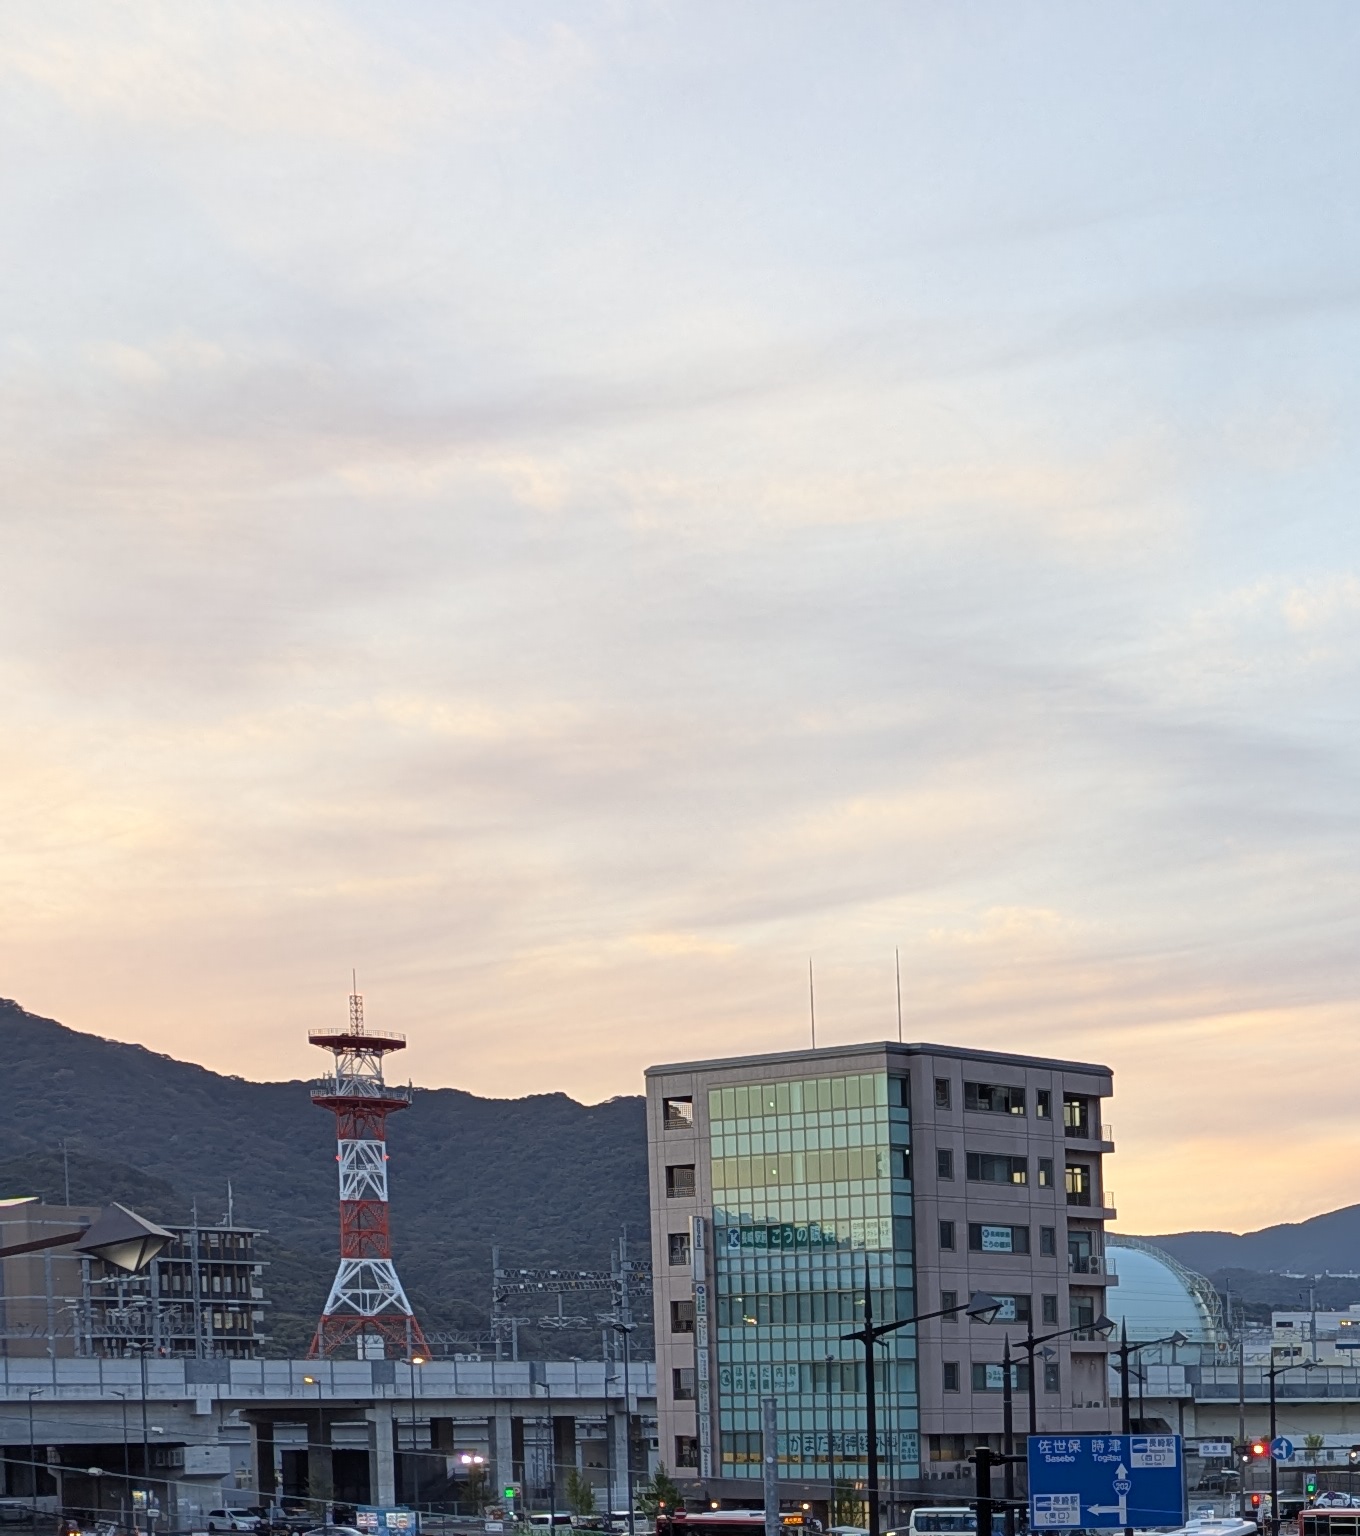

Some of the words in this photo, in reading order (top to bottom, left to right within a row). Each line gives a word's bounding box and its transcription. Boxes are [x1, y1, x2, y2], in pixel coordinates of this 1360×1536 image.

[1037, 1439, 1082, 1454] 佐世保
[1091, 1438, 1122, 1454] 時津
[1045, 1454, 1075, 1463] Sasebo
